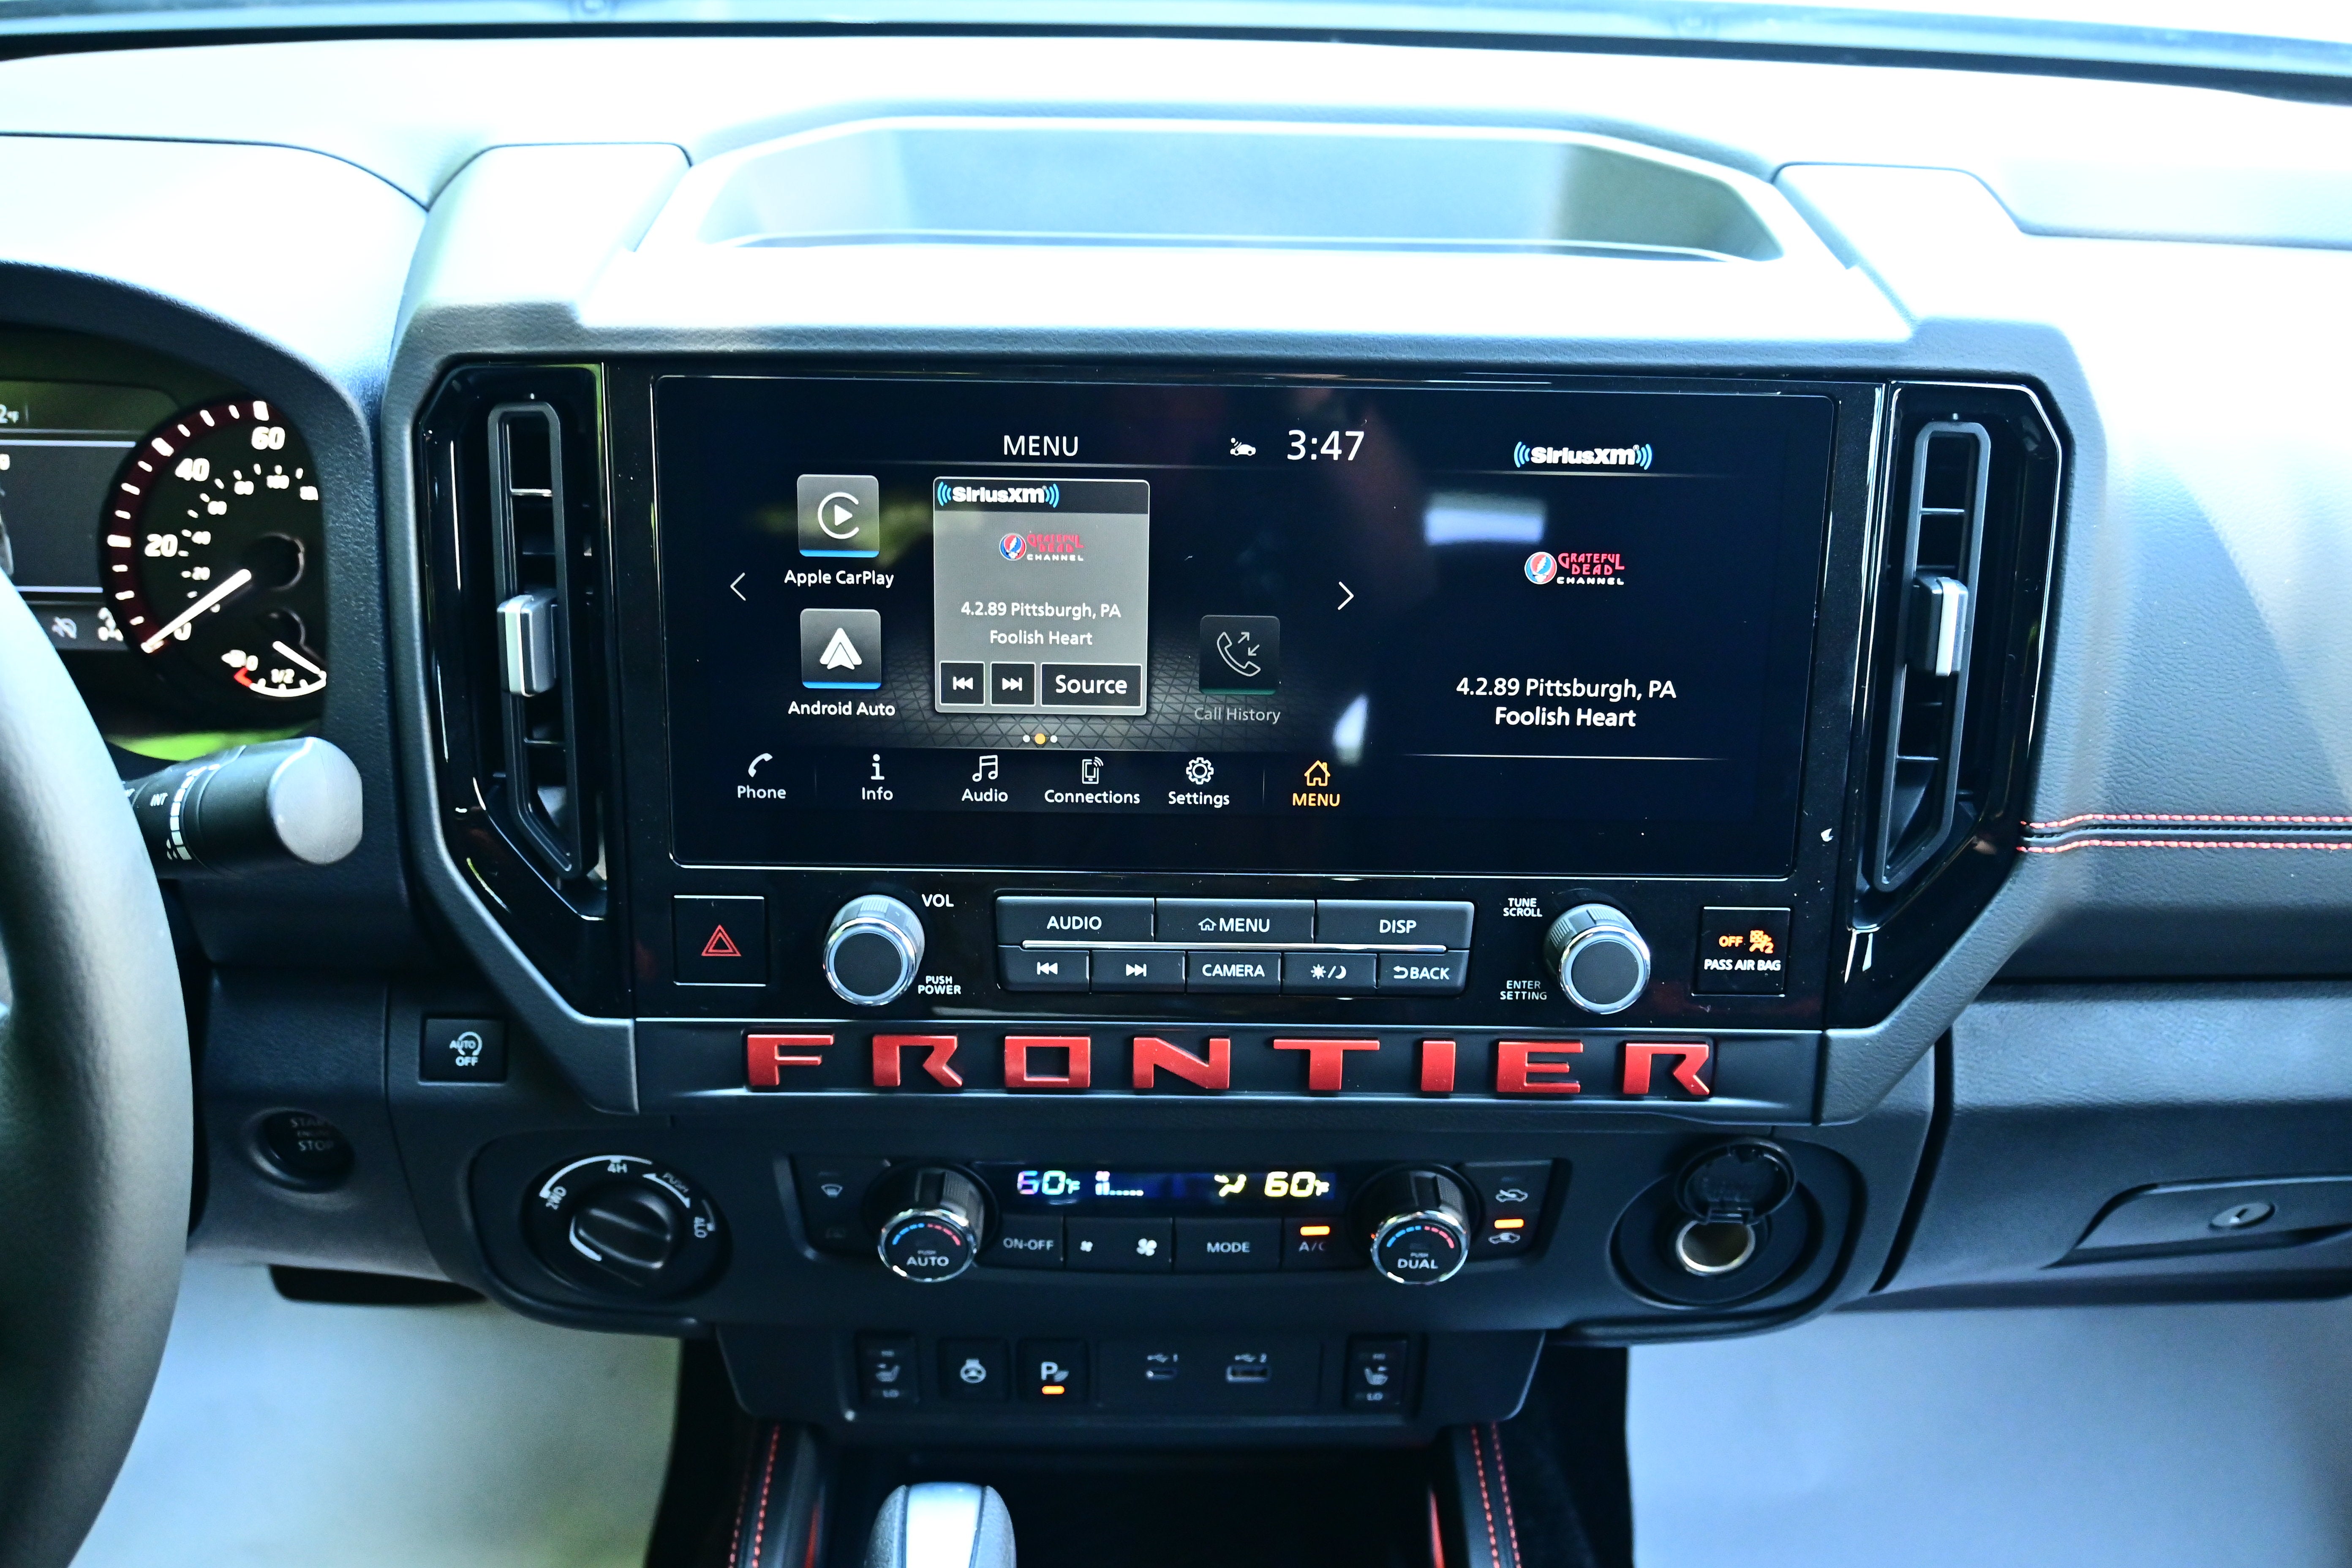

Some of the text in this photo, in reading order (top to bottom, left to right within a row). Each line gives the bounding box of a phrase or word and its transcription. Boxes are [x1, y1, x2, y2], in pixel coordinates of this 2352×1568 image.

[251, 427, 285, 449] 60
[1004, 435, 1078, 456] MENU
[1288, 430, 1364, 460] 3:47
[175, 458, 210, 481] 40
[144, 534, 179, 557] 20
[1558, 553, 1625, 570] GRATEFUL
[1572, 564, 1612, 575] DEAD
[784, 569, 894, 588] Apple CarPlay
[1557, 577, 1624, 585] CHANNEL
[961, 602, 1121, 621] 4.2.89 Pittsburgh, PA
[990, 630, 1092, 645] Foolish Heart
[1056, 675, 1127, 694] Source
[1456, 678, 1676, 702] 4.2.89 Pittsburgh, PA
[788, 701, 895, 716] Android Auto
[1194, 708, 1280, 724] Call History
[1496, 706, 1636, 727] Foolish Heart
[738, 785, 786, 799] Phone
[862, 787, 893, 800] Info
[962, 788, 1008, 802] Audio
[1045, 789, 1140, 803] Connections
[1169, 791, 1229, 808] Settings
[1293, 793, 1339, 806] MENU
[922, 894, 954, 907] VOL
[1508, 898, 1536, 907] TUNE
[1503, 907, 1542, 917] SCROLL
[1047, 916, 1102, 930] AUDIO
[1220, 918, 1269, 932] MENU
[1380, 920, 1416, 933] DISP
[1719, 936, 1743, 947] OFF
[1203, 964, 1265, 977] CAMERA
[1704, 959, 1780, 971] PASS AIR BAG
[1410, 967, 1449, 980] BACK
[926, 976, 952, 985] PUSH
[1507, 980, 1541, 990] ENTER
[918, 985, 961, 995] POWER
[1500, 991, 1547, 1000] SETTING
[456, 1056, 478, 1066] OFF
[747, 1034, 1710, 1095] FRONTIER
[607, 1163, 628, 1173] 4H
[1003, 1238, 1053, 1250] ON-OFF
[1207, 1242, 1250, 1252] MODE
[1299, 1241, 1326, 1251] A/C
[906, 1256, 949, 1266] AUTO
[1397, 1258, 1438, 1269] DUAL
